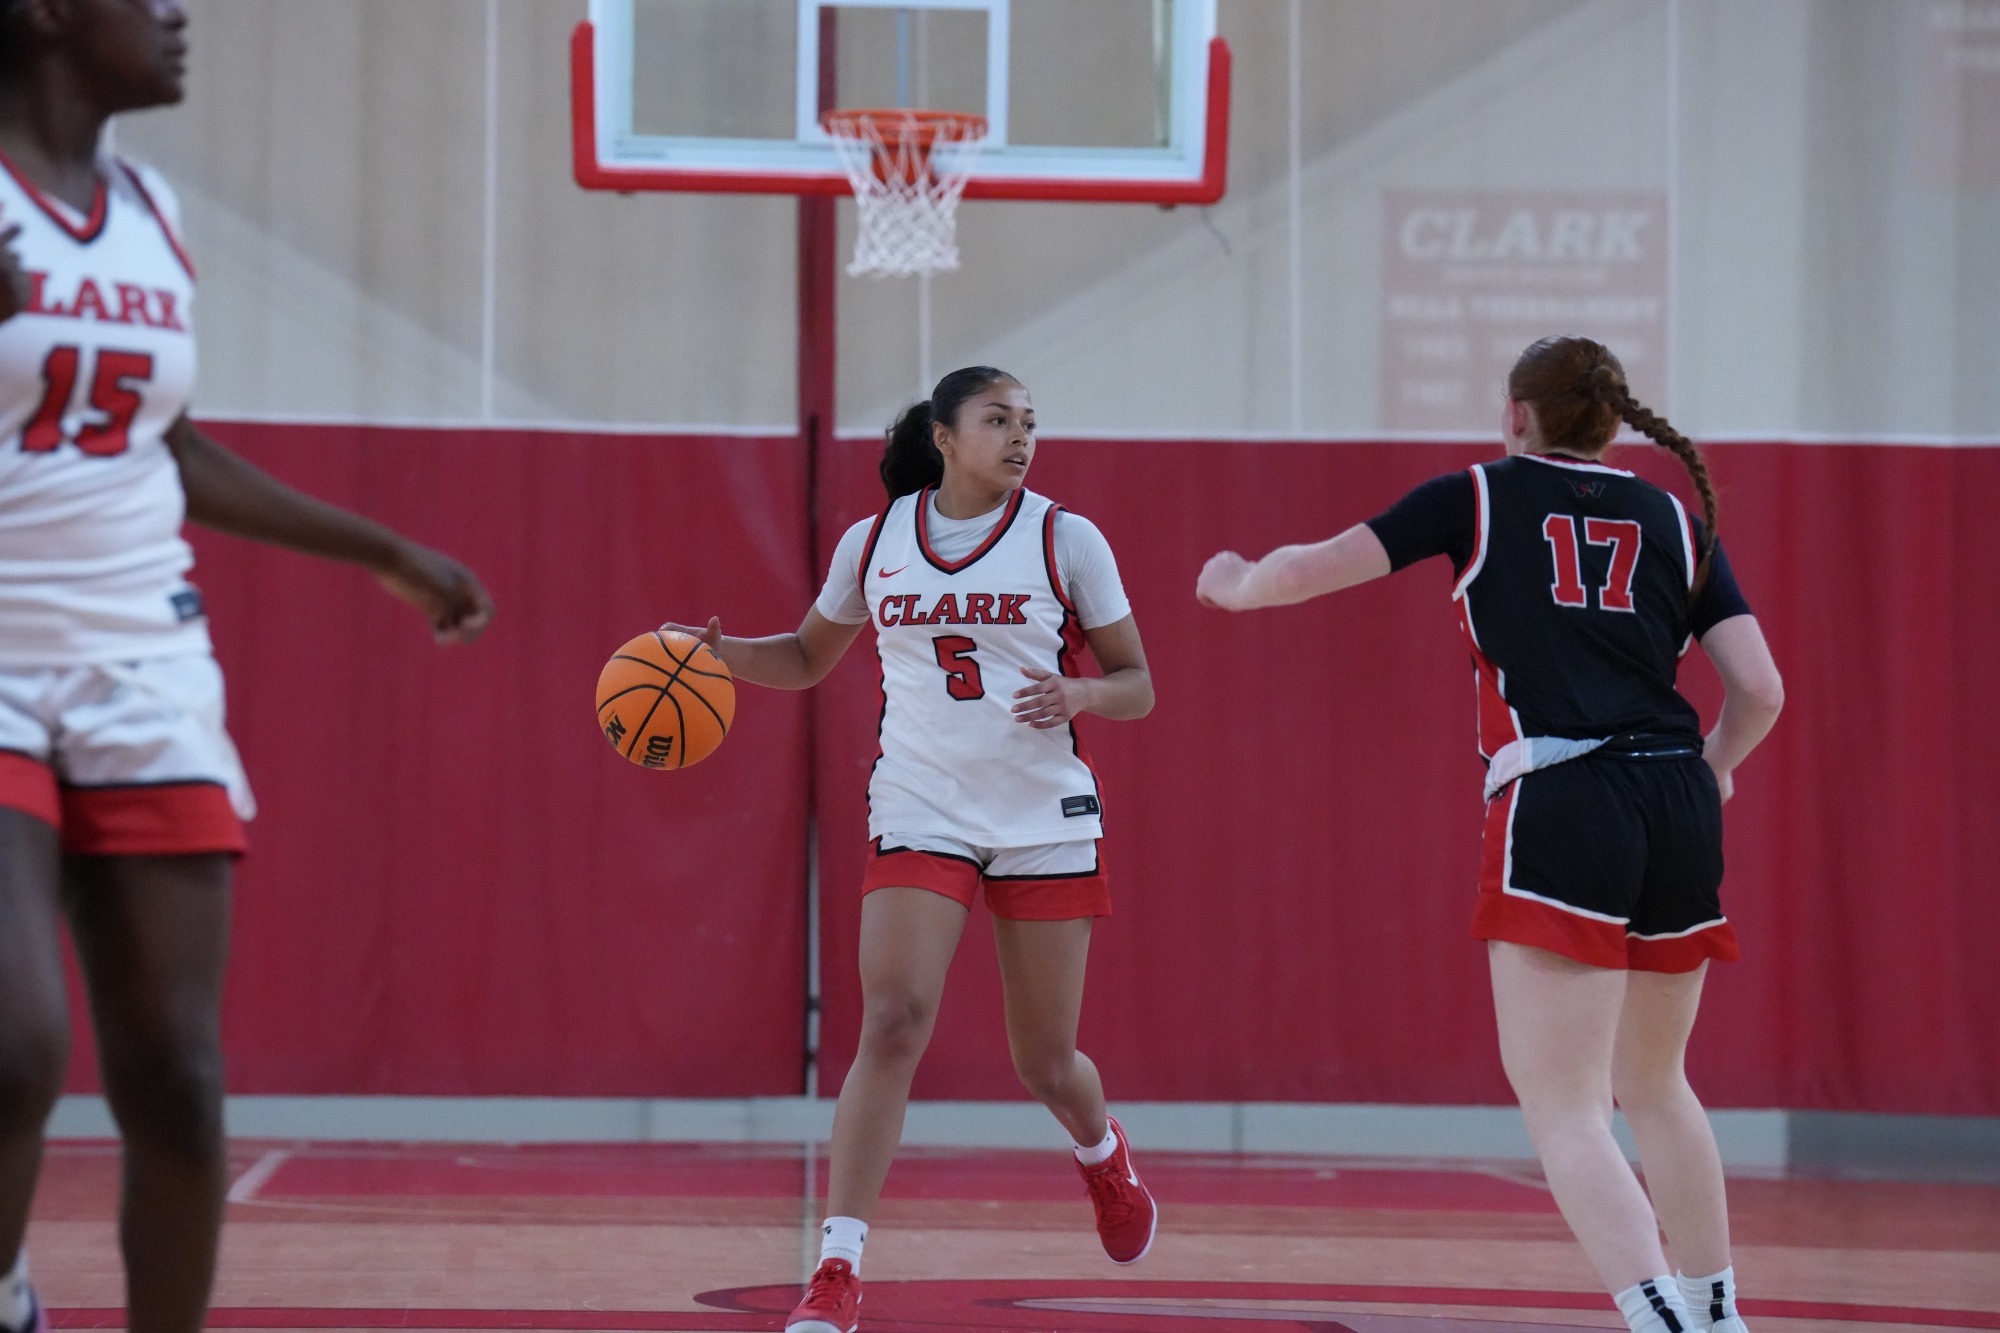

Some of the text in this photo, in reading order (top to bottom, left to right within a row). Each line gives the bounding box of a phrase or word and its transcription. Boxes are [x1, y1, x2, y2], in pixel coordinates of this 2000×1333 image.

[1400, 207, 1649, 260] CLARK
[25, 269, 186, 333] LARK
[18, 344, 155, 458] 15
[1541, 512, 1642, 614] 17
[878, 592, 1032, 627] CLARK
[931, 634, 986, 702] 5
